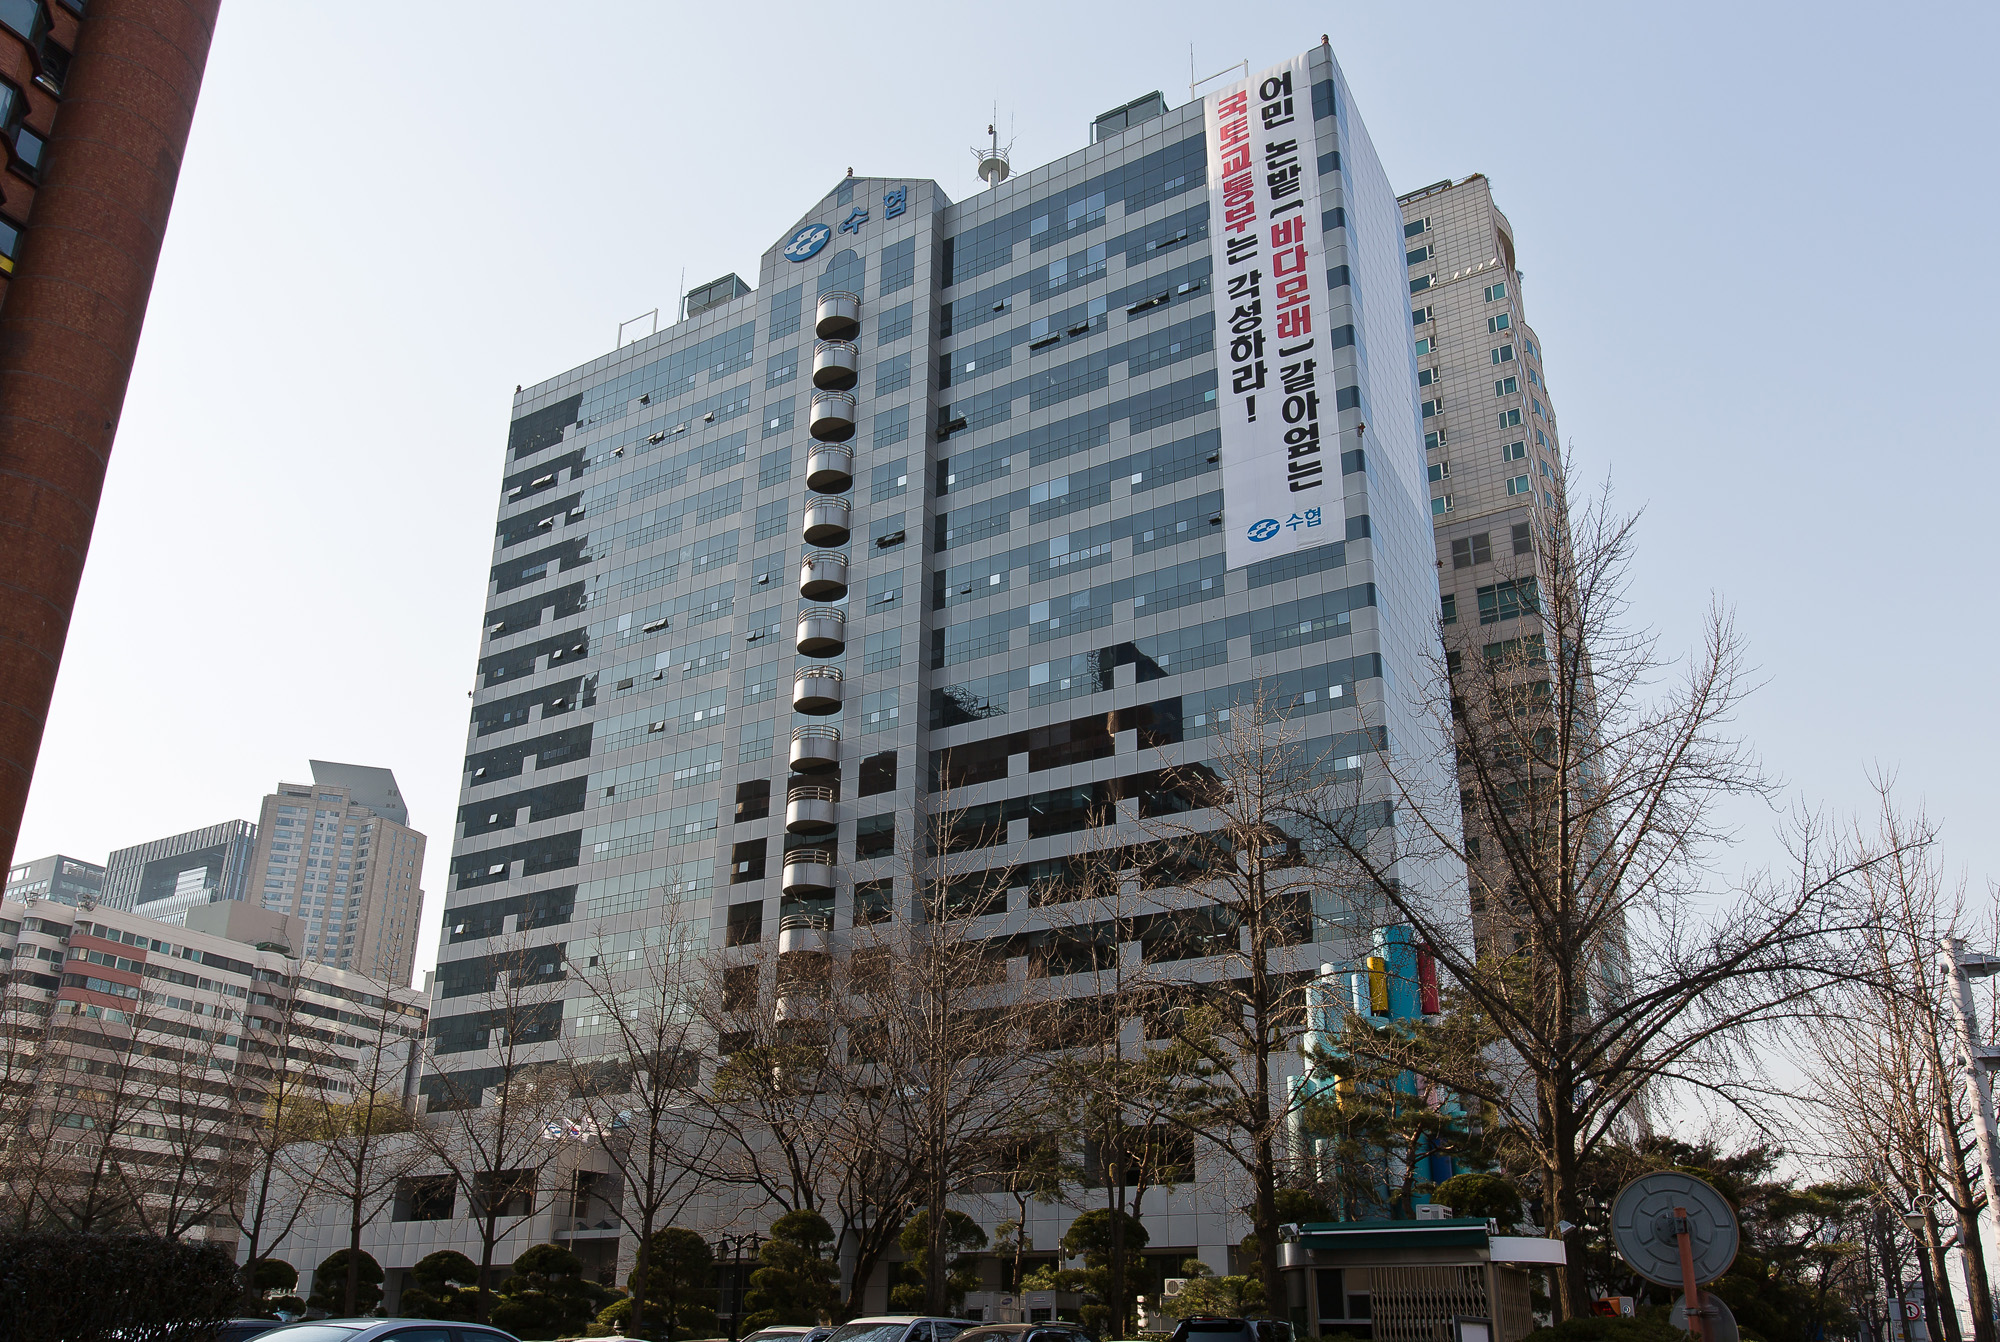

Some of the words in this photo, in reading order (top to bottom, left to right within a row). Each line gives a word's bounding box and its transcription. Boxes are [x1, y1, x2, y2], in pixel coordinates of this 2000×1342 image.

[1259, 70, 1294, 131] 어민
[1217, 89, 1259, 265] 국토교통부는
[837, 184, 908, 235] 수협
[1226, 268, 1268, 423] 각성하라!
[1284, 506, 1322, 532] 수협
